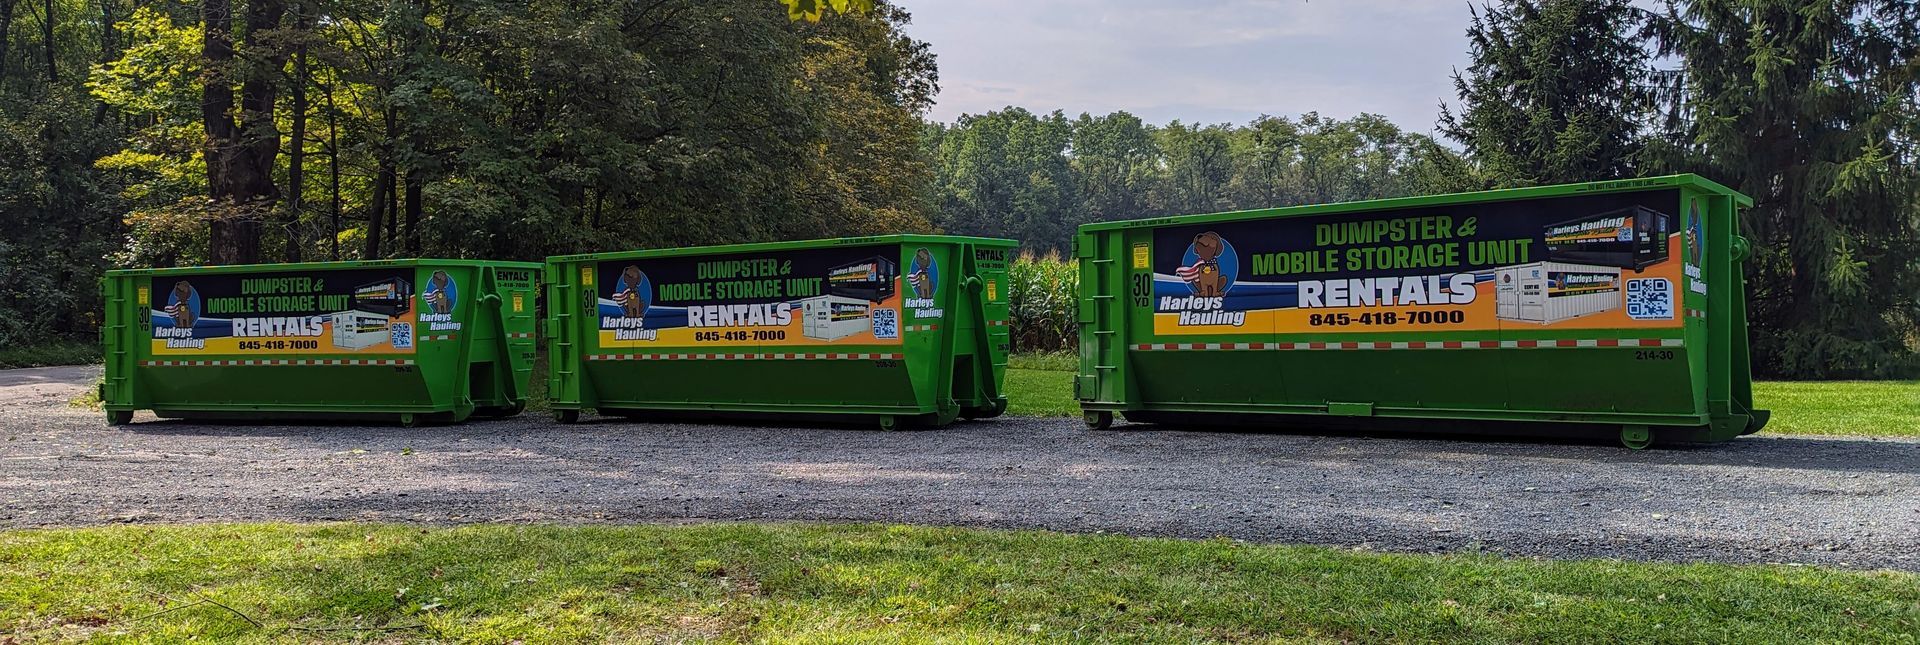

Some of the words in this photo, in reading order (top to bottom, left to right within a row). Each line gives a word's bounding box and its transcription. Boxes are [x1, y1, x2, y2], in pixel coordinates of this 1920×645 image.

[1316, 216, 1453, 247] DUMPSTER
[1457, 216, 1477, 237] &
[1553, 224, 1580, 235] Harleys
[1581, 216, 1625, 231] Hauling
[976, 249, 1004, 261] ENTALS
[1252, 250, 1339, 276] MOBILE
[1346, 243, 1459, 271] STORAGE
[1468, 238, 1533, 266] UNIT
[496, 271, 529, 281] ENTALS
[698, 258, 777, 280] DUMPSTER
[780, 259, 792, 275] &
[241, 277, 312, 295] DUMPSTER
[313, 277, 324, 291] &
[1133, 273, 1151, 297] 30
[1567, 274, 1592, 283] Harleys
[659, 282, 712, 301] MOBILE
[716, 280, 782, 299] STORAGE
[786, 277, 823, 297] UNIT
[1298, 273, 1476, 308] RENTALS
[207, 297, 256, 313] MOBILE
[257, 295, 315, 312] STORAGE
[319, 294, 349, 311] UNIT
[584, 289, 595, 308] 30
[904, 297, 934, 308] Harleys
[1134, 297, 1149, 307] YD
[1159, 296, 1223, 311] Harleys
[139, 306, 149, 324] 30
[419, 312, 451, 323] Harleys
[687, 303, 793, 328] RENTALS
[914, 307, 943, 319] Hauling
[1178, 311, 1246, 327] Hauling
[1309, 310, 1465, 326] 845-418-7000
[232, 315, 324, 337] RENTALS
[430, 321, 461, 331] Hauling
[602, 316, 643, 328] Harleys
[155, 327, 192, 338] Harleys
[615, 328, 657, 341] Hauling
[695, 330, 786, 341] 845-418-7000
[166, 337, 205, 349] Hauling
[239, 340, 318, 350] 845-418-7000
[1635, 351, 1673, 360] 214-30
